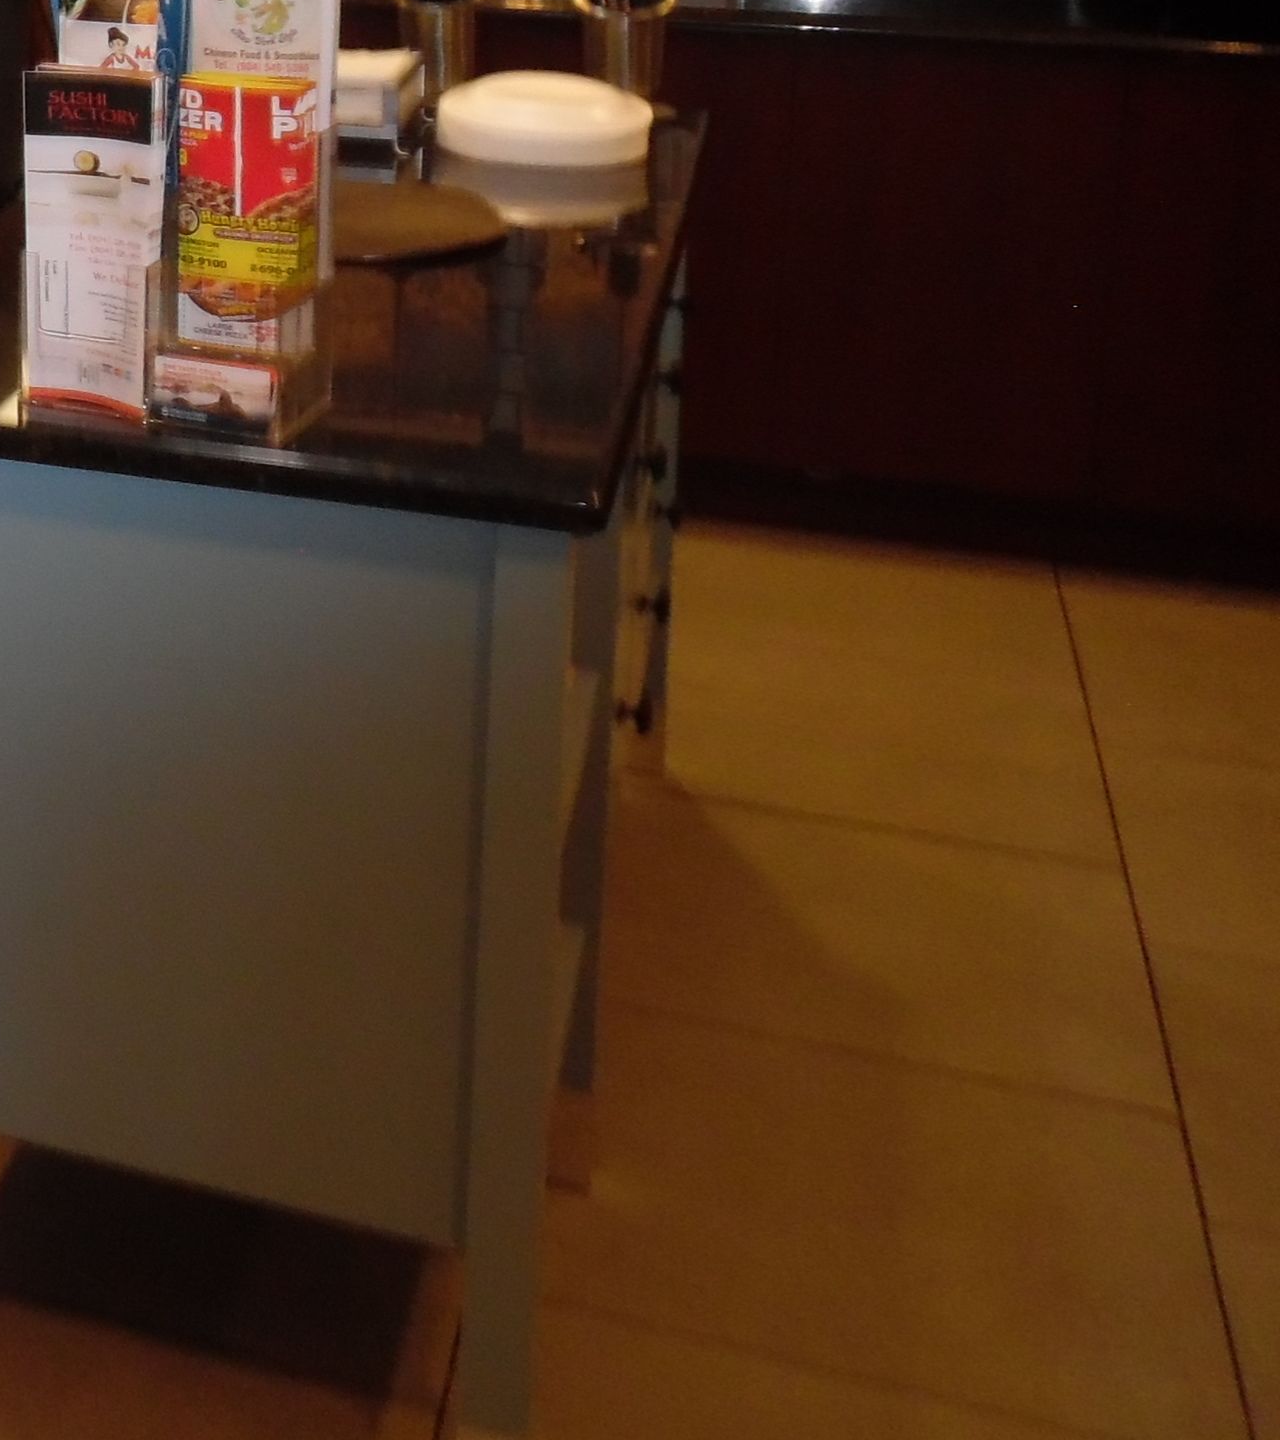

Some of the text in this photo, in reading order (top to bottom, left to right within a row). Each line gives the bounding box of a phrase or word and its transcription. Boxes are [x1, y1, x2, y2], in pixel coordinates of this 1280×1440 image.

[48, 89, 108, 107] SUSHI
[48, 105, 140, 127] FACTORY
[200, 208, 256, 232] Hungry
